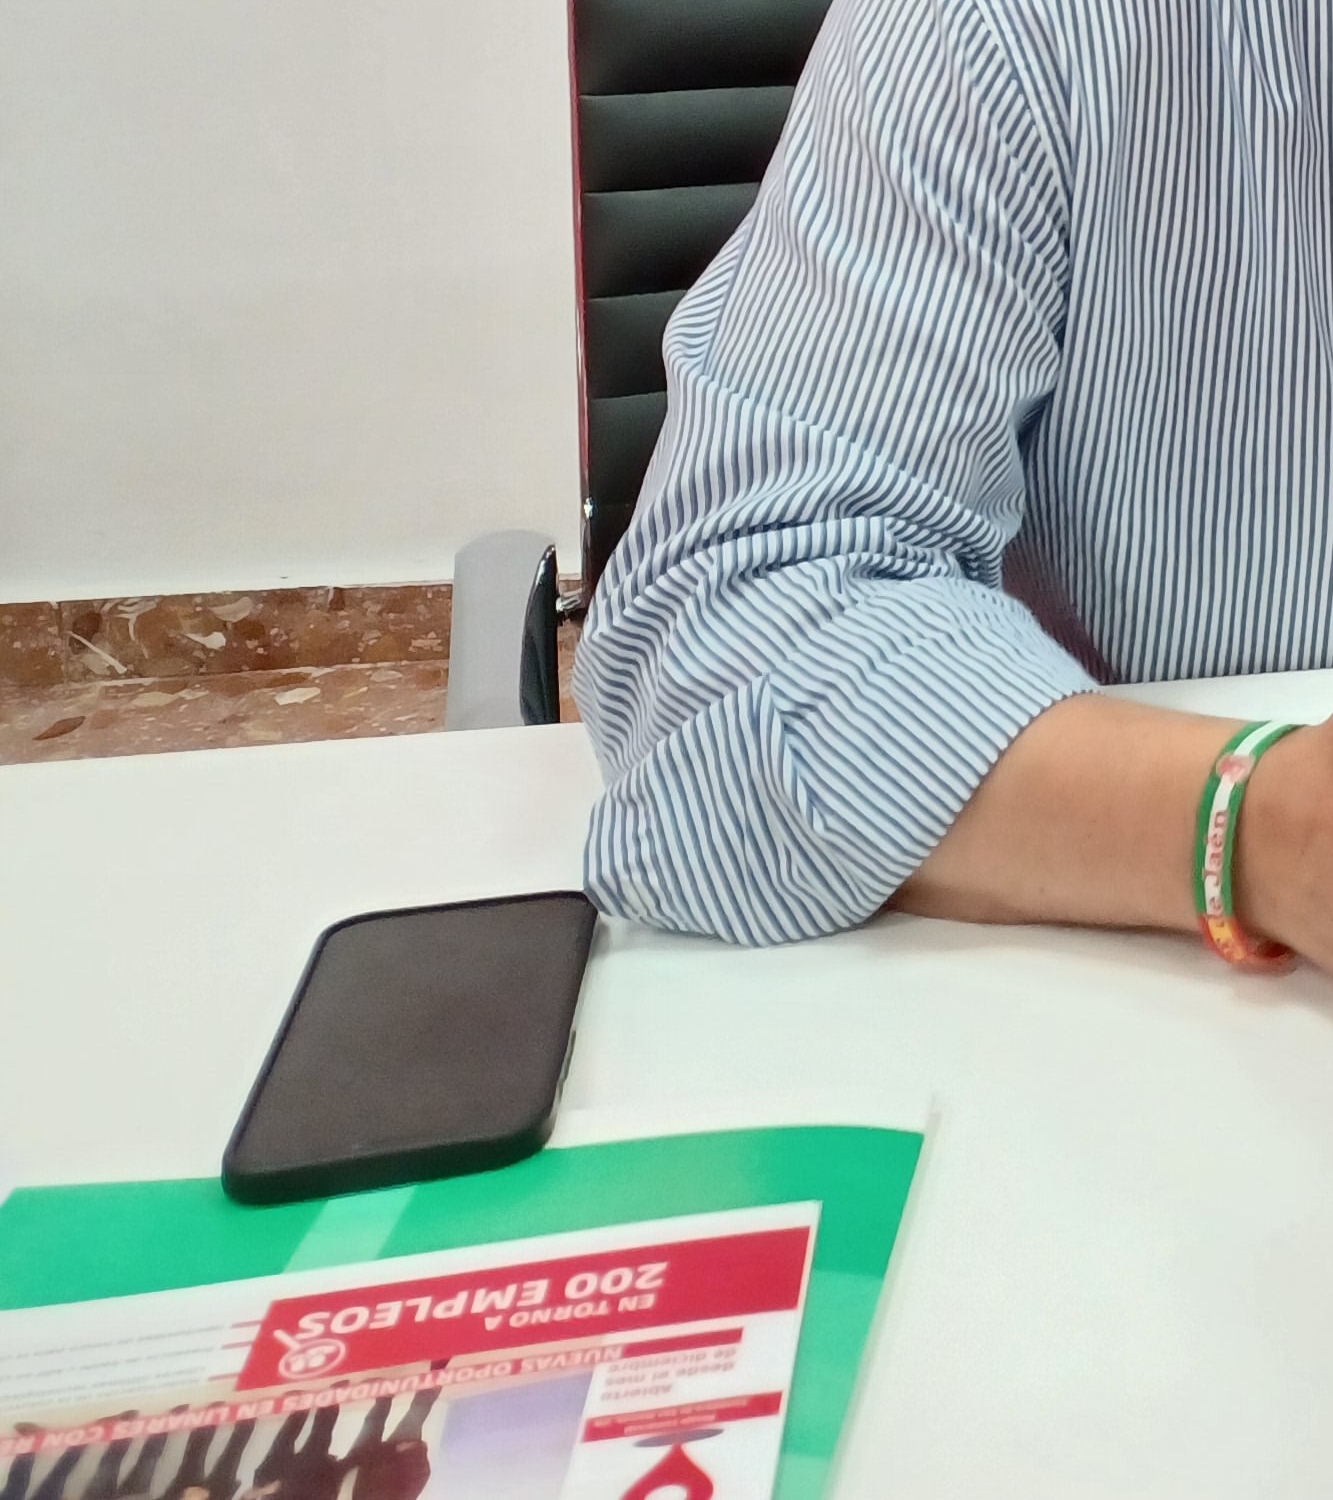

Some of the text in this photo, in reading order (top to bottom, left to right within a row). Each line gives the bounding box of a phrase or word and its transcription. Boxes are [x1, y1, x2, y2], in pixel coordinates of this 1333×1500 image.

[296, 1262, 670, 1339] 200 EMPLEOS
[483, 1293, 657, 1332] EN TORNO A
[521, 1346, 624, 1374] NUEVAS
[281, 1361, 513, 1414] OPORTUNIDADES
[112, 1407, 230, 1440] LINARES
[237, 1398, 272, 1419] EN
[42, 1426, 106, 1449] CON
